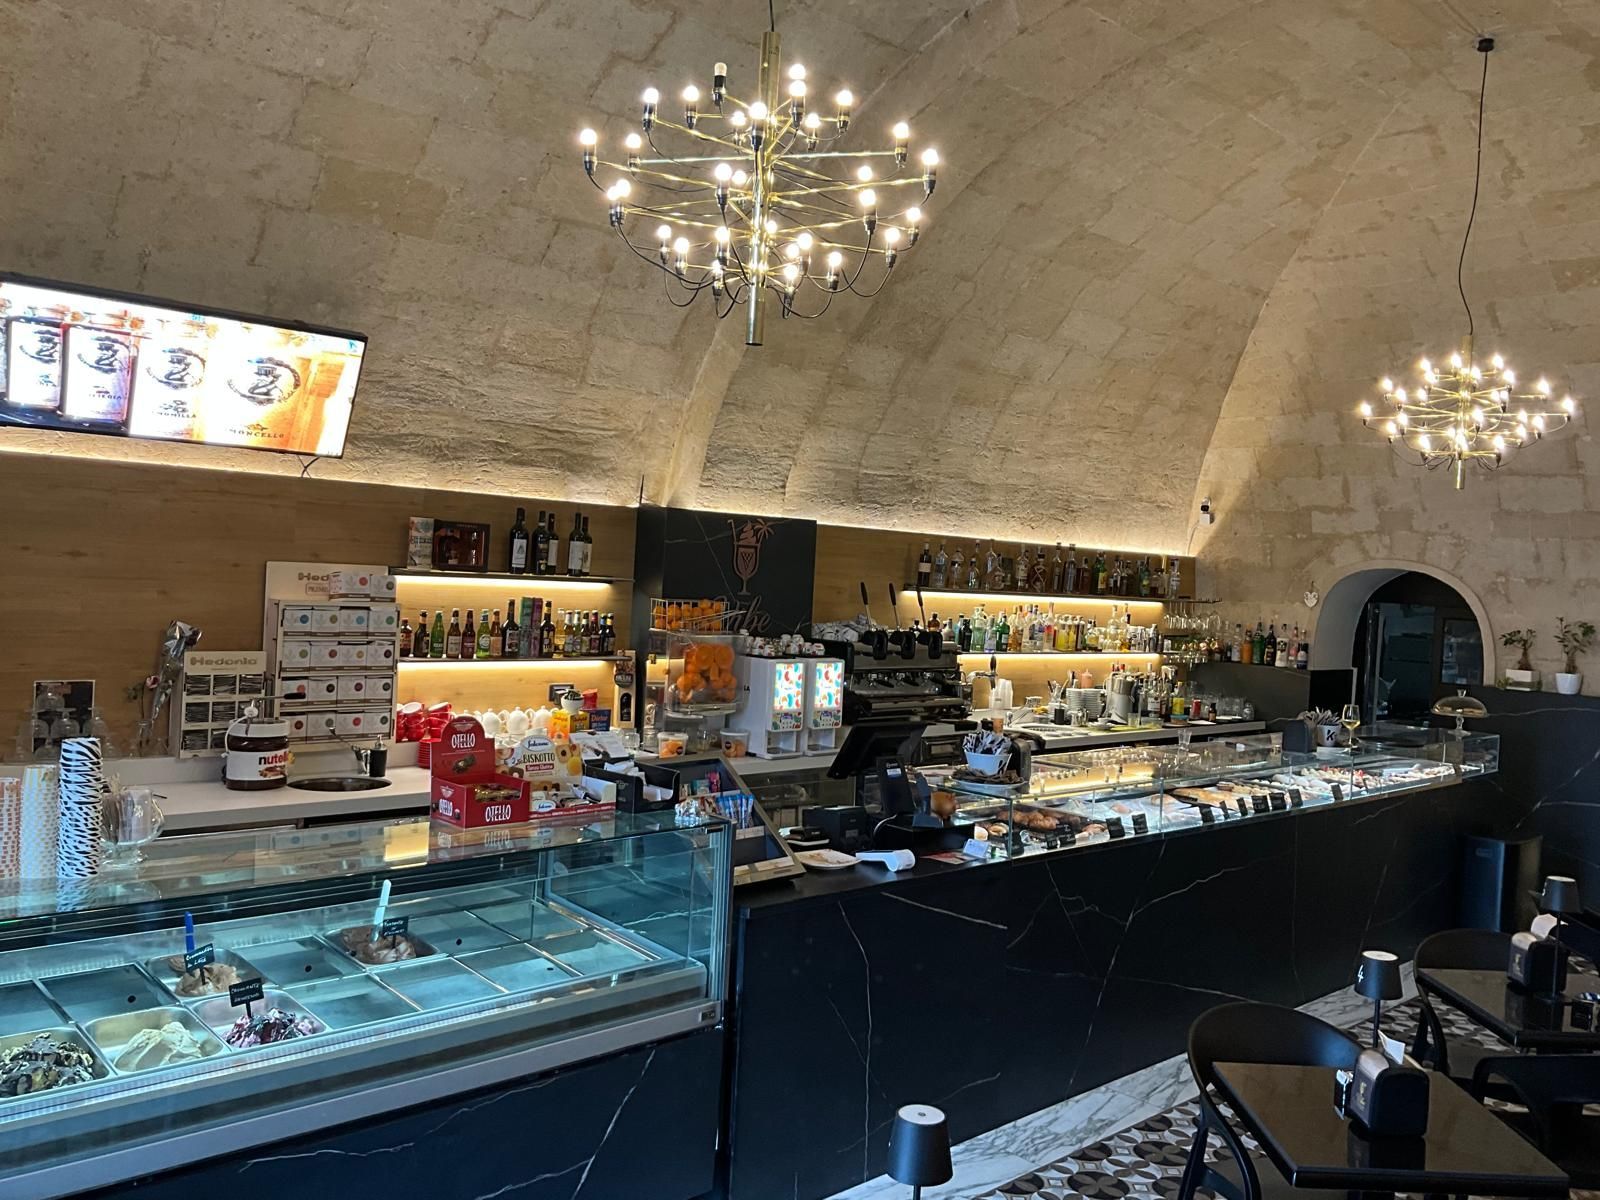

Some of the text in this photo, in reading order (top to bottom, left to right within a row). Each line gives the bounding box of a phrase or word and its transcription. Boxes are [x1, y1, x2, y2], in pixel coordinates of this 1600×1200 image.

[298, 572, 330, 581] Hed
[190, 656, 257, 666] Hedonia
[451, 732, 476, 749] OTELLO
[258, 751, 291, 765] nutell
[522, 752, 556, 764] BISKOTTO
[485, 804, 512, 823] OTELLO
[1357, 964, 1364, 983] 4
